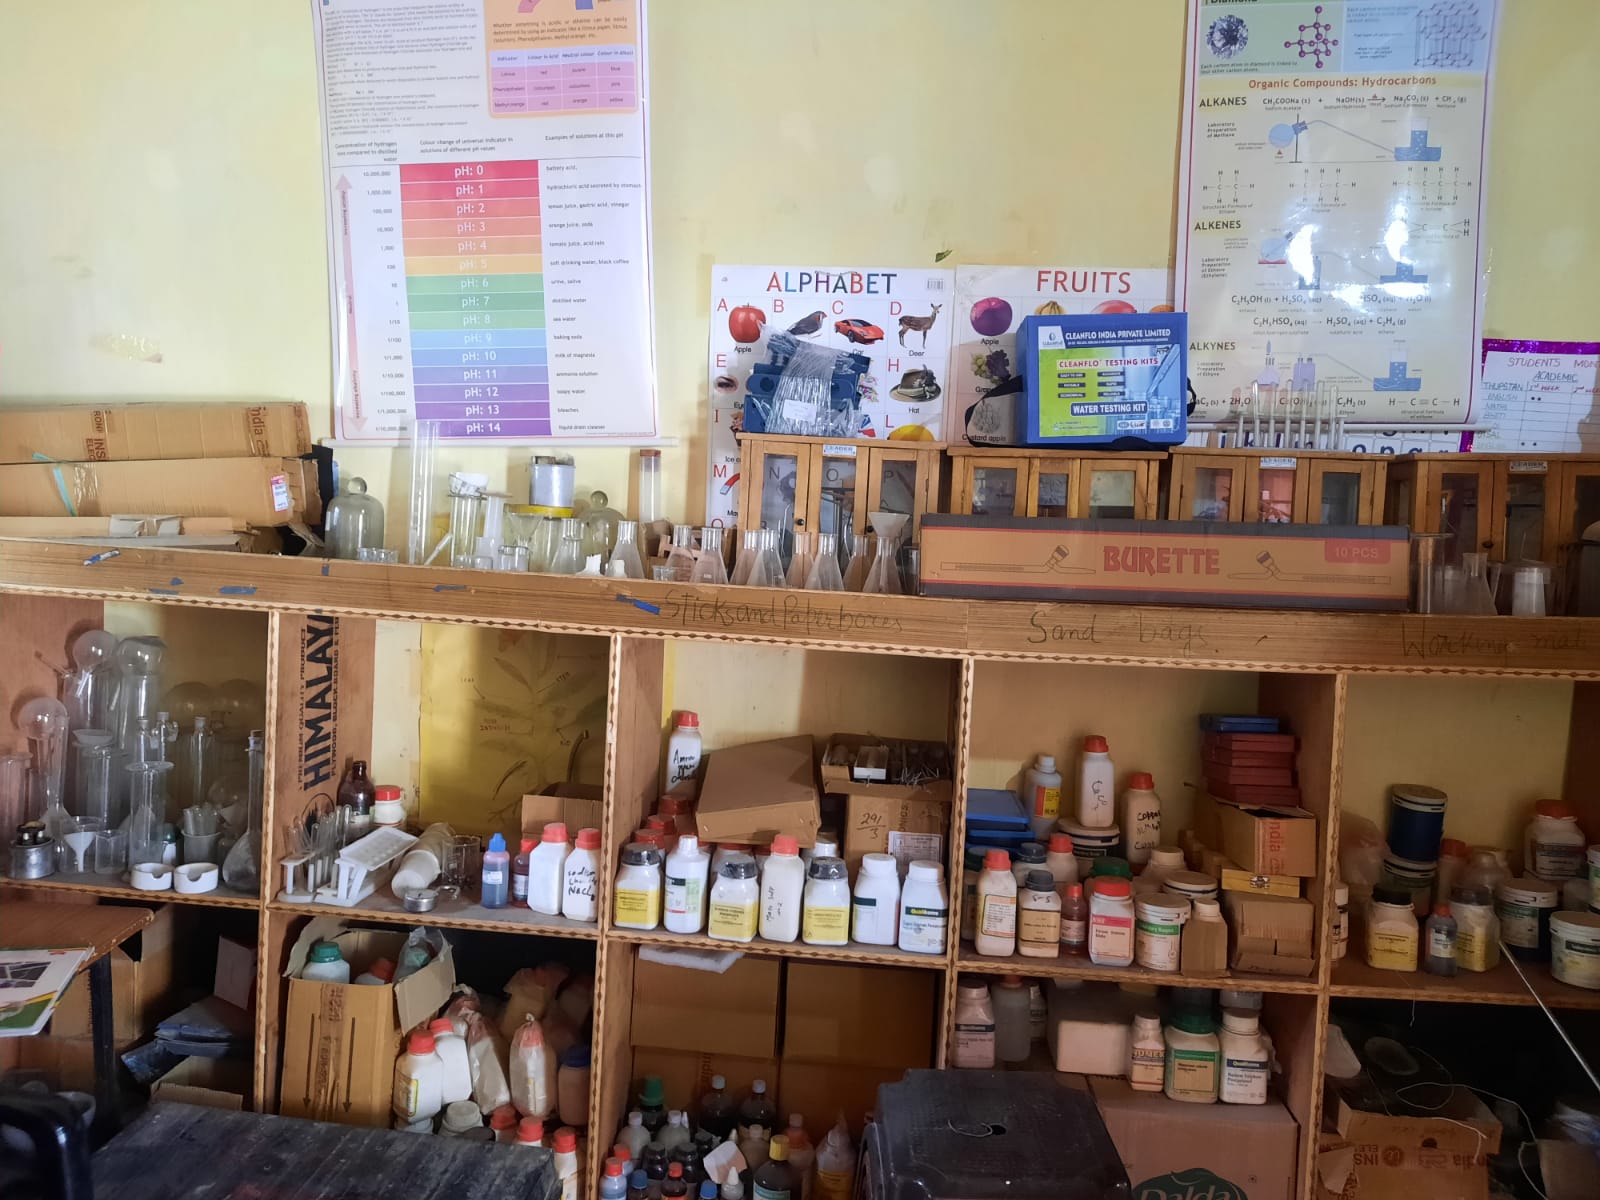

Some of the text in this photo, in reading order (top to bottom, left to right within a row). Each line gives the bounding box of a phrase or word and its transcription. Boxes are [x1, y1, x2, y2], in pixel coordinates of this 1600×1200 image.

[1248, 76, 1437, 90] Organic Compounds: Hydrocarbons
[1199, 96, 1248, 108] ALKANES
[455, 164, 484, 178] pH: 0
[456, 184, 484, 197] pH: 1
[456, 202, 486, 216] pH: 2
[457, 222, 486, 235] pH: 3
[1194, 220, 1242, 232] ALKENES
[458, 240, 487, 253] pH: 4
[460, 259, 488, 272] pH: 5
[461, 278, 489, 290] pH: 6
[766, 271, 898, 294] ALPHABET
[1036, 270, 1132, 294] FRUITS
[462, 296, 490, 308] pH: 7
[716, 298, 728, 312] A
[773, 299, 784, 313] B
[832, 300, 844, 314] C
[890, 301, 902, 316] D
[464, 314, 491, 327] pH: 8
[464, 333, 492, 346] pH: 9
[1066, 328, 1171, 340] CLEANFLO INDIA PRIVATE LIMITED
[980, 338, 999, 346] Apple
[1190, 342, 1236, 351] ALKYNES
[734, 345, 752, 354] Apple
[462, 351, 496, 363] pH: 10
[716, 354, 727, 368] E
[1105, 358, 1138, 366] TESTING
[1507, 358, 1561, 368] STUDENTS
[888, 358, 900, 372] H
[464, 369, 497, 381] pH: 11
[1534, 370, 1578, 381] ACADEMIC
[465, 387, 500, 399] pH: 12
[466, 404, 500, 417] pH: 13
[908, 406, 920, 414] Hat
[1073, 402, 1146, 414] WATER TESTING KIT
[886, 414, 894, 428] L
[467, 422, 500, 434] pH: 14
[962, 434, 1007, 444] Cstard apple
[713, 464, 727, 478] M
[769, 466, 781, 480] N
[826, 468, 840, 482] O
[884, 470, 894, 484] P
[1334, 546, 1379, 559] 10 PCS
[1102, 545, 1220, 576] BURETTE
[1027, 611, 1100, 644] Sand
[861, 812, 882, 825] 291
[870, 828, 878, 840] 3
